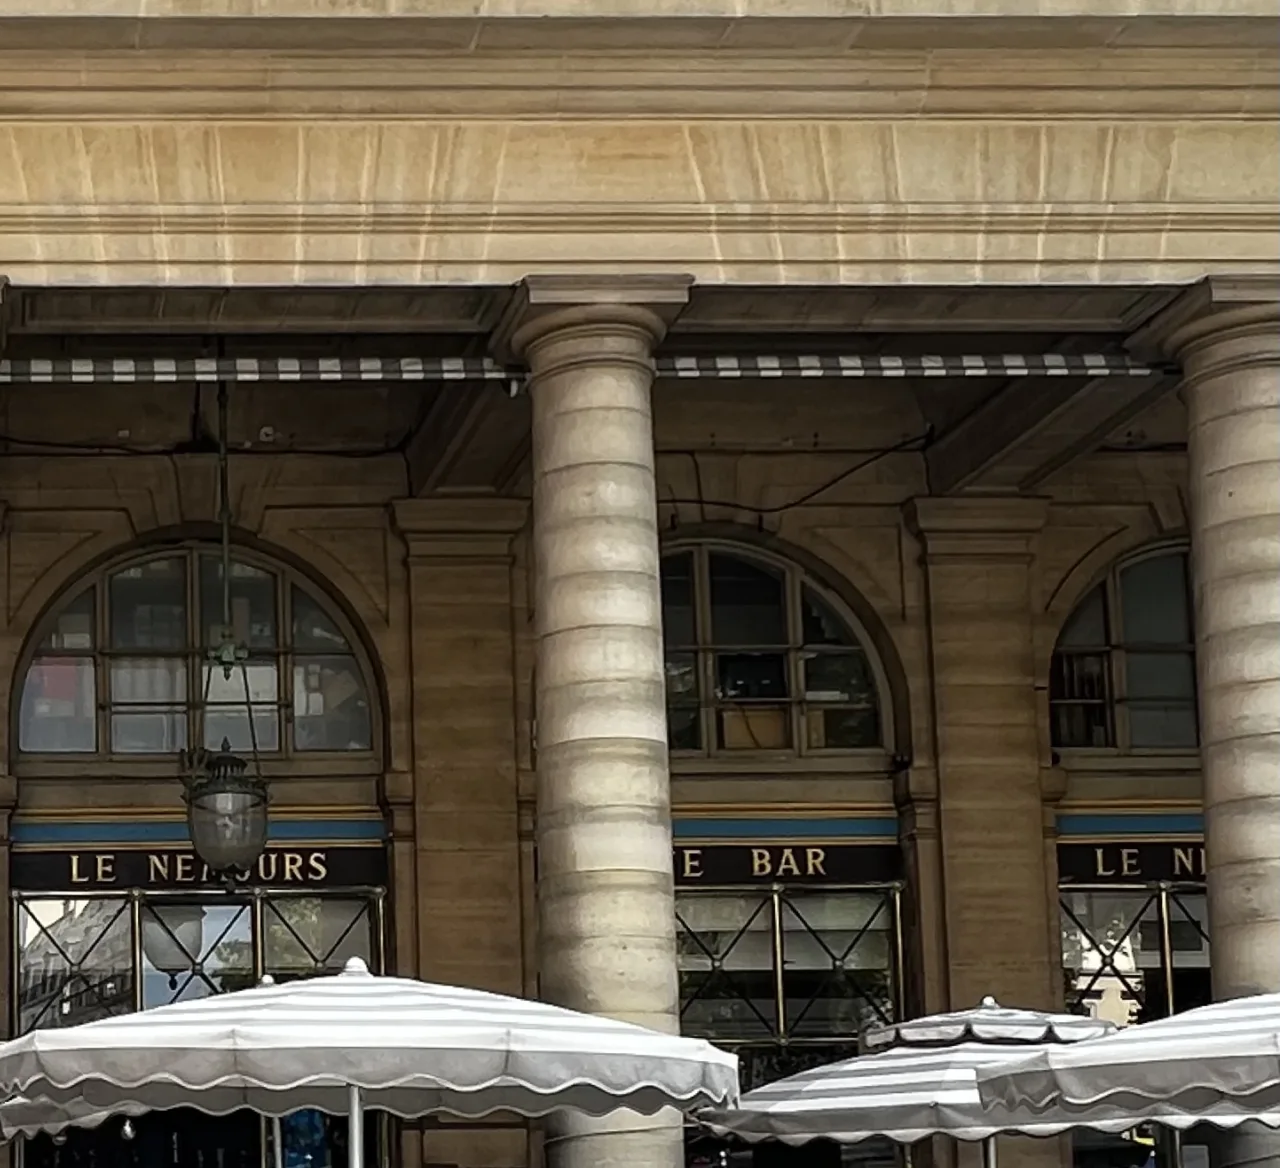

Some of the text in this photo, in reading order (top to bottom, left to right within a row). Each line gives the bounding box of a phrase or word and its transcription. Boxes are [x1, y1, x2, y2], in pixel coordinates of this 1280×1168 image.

[71, 853, 328, 881] LE NEURS
[673, 849, 826, 877] E BAR
[1095, 848, 1142, 876] LE
